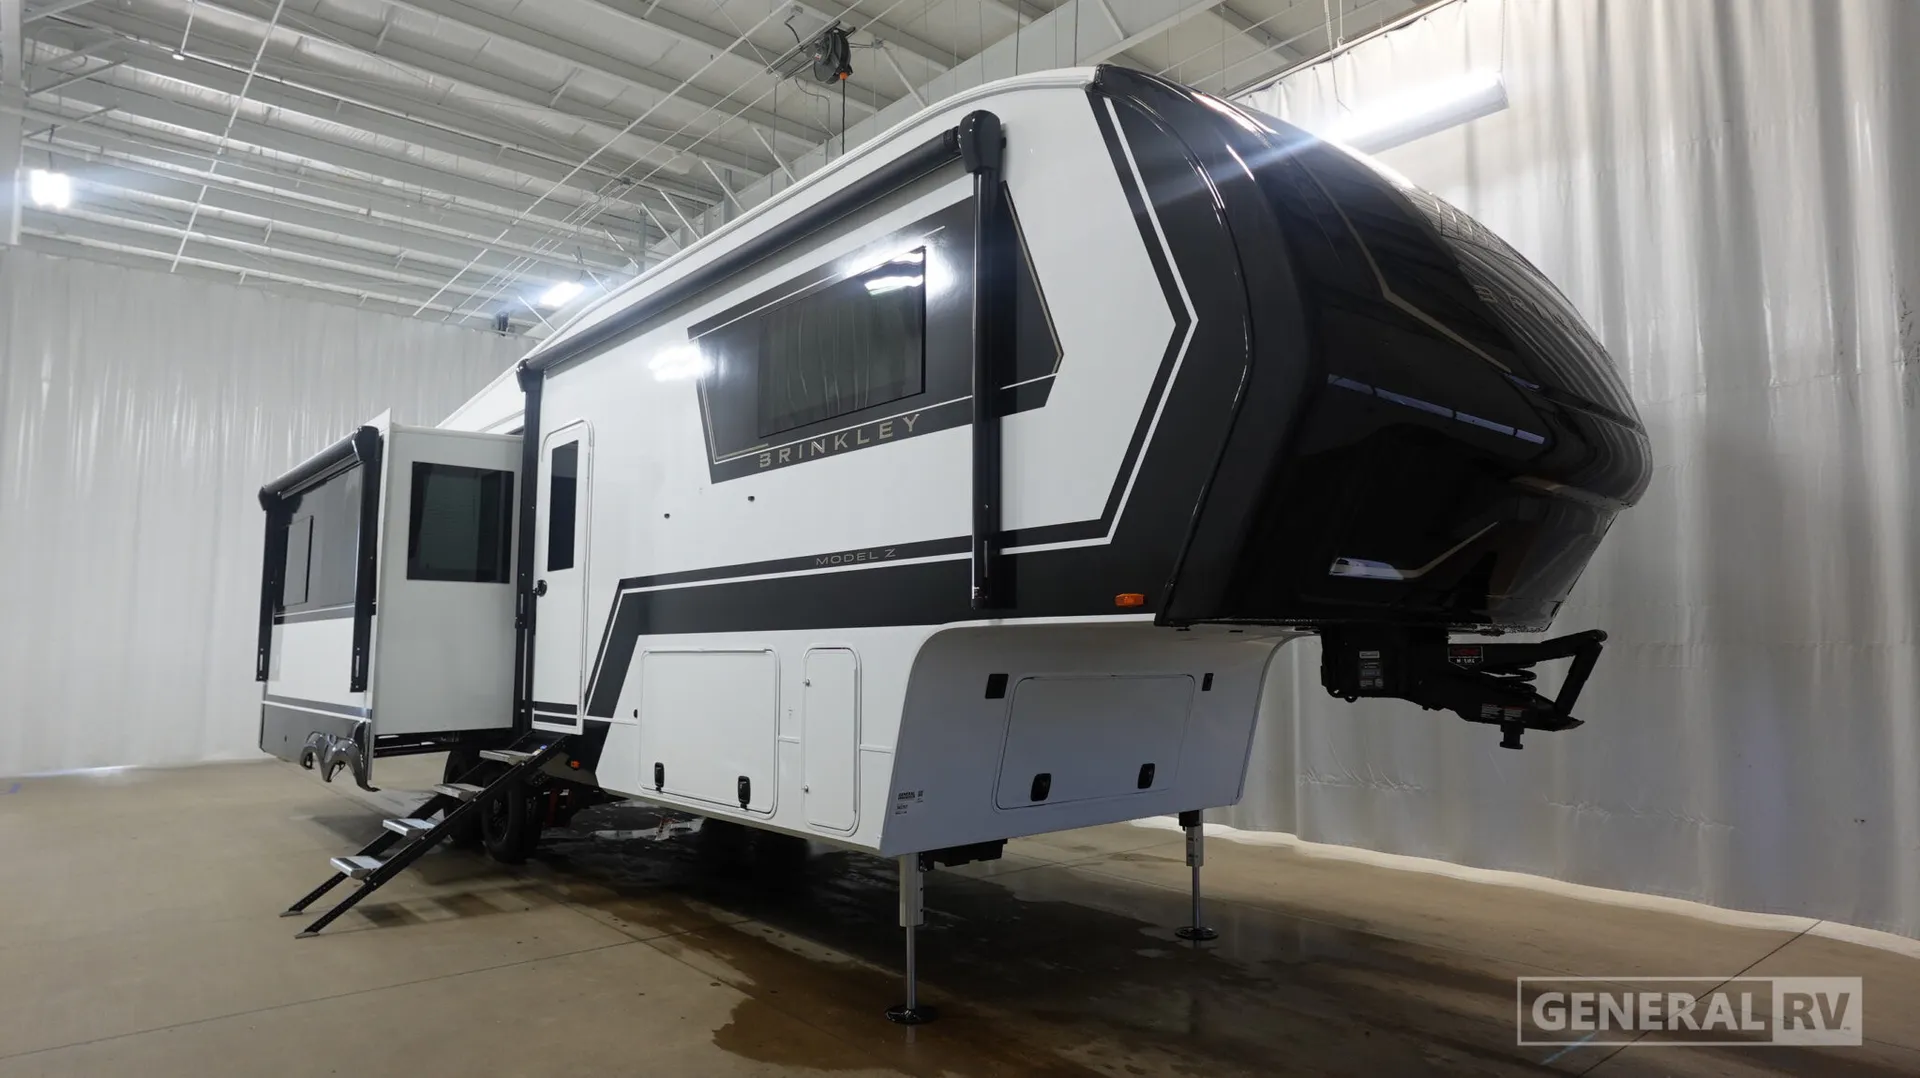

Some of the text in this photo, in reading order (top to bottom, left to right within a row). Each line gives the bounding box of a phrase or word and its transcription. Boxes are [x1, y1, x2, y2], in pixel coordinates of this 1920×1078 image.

[759, 413, 920, 468] BRINKLEY
[815, 547, 897, 566] MODEL Z
